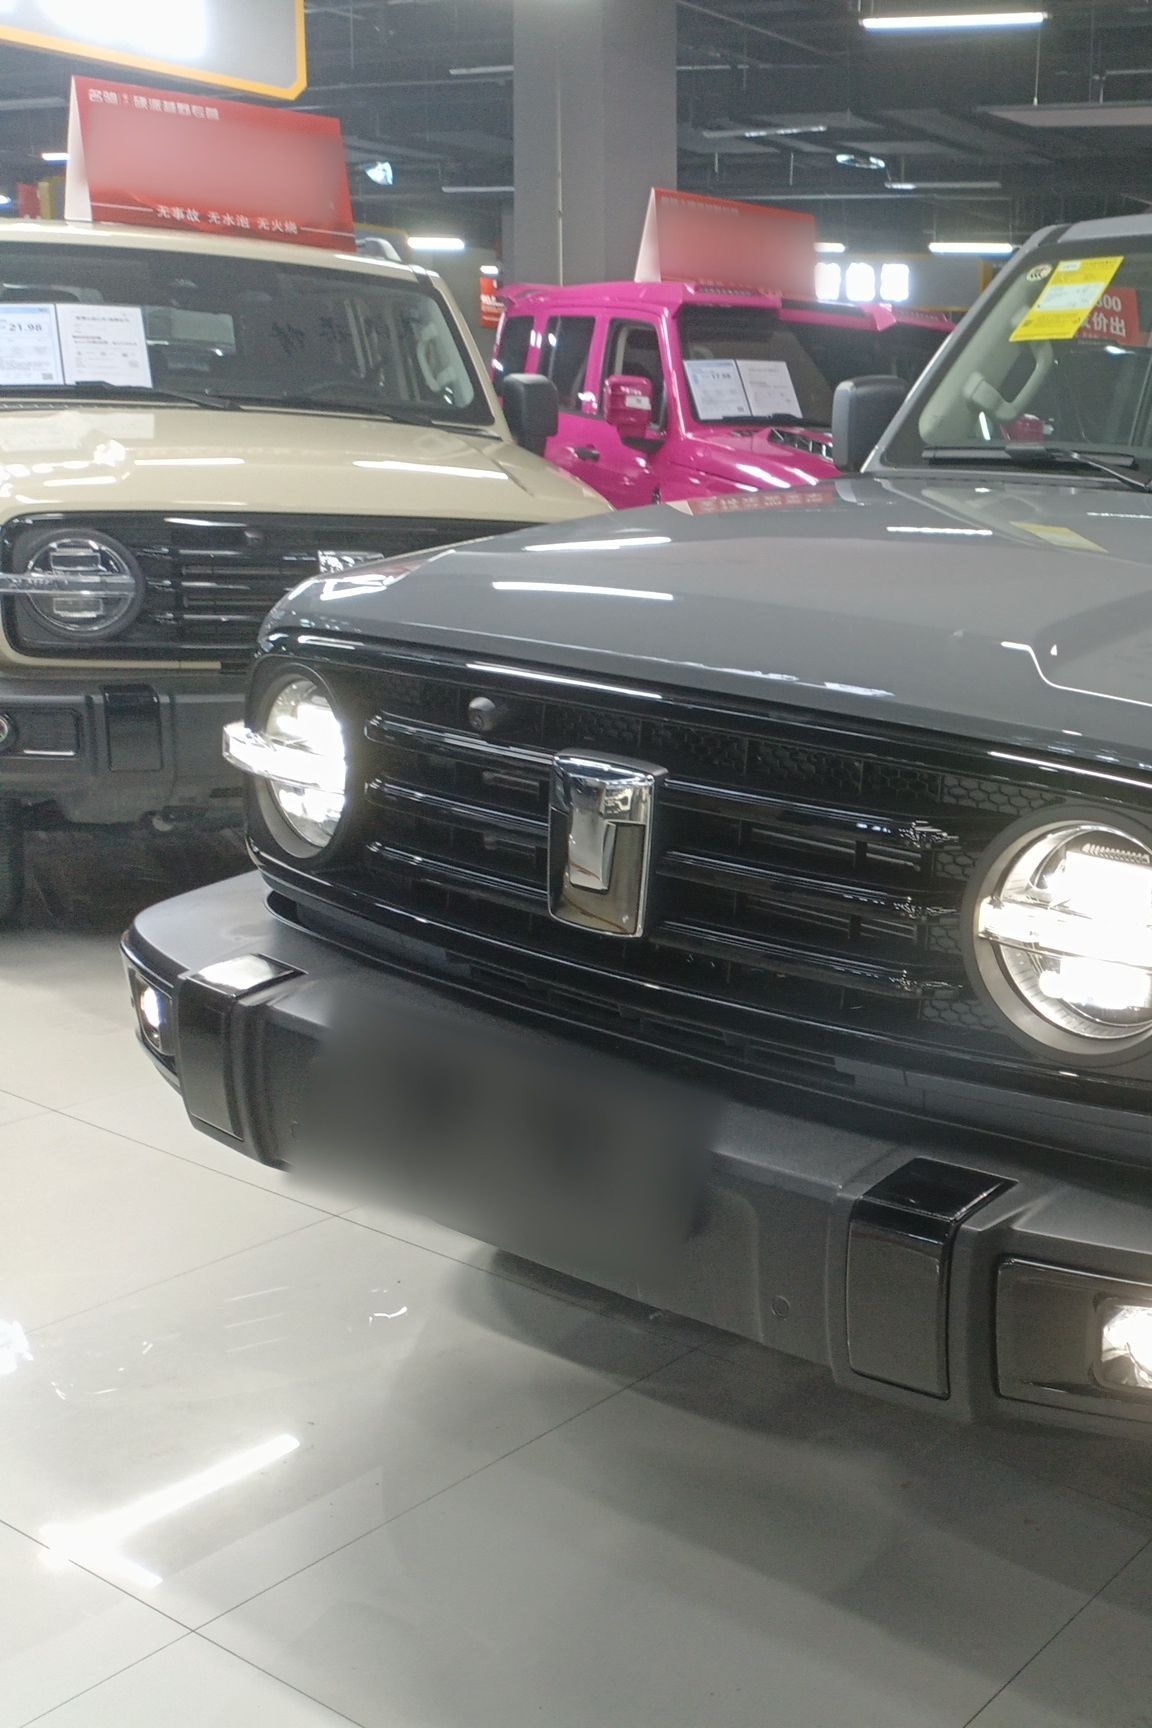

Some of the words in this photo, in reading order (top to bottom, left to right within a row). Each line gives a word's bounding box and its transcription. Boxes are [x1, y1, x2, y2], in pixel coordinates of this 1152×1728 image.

[155, 204, 200, 223] 无事故
[207, 210, 250, 229] 无水泡
[256, 217, 298, 235] 无火烧
[1083, 311, 1126, 337] 价出
